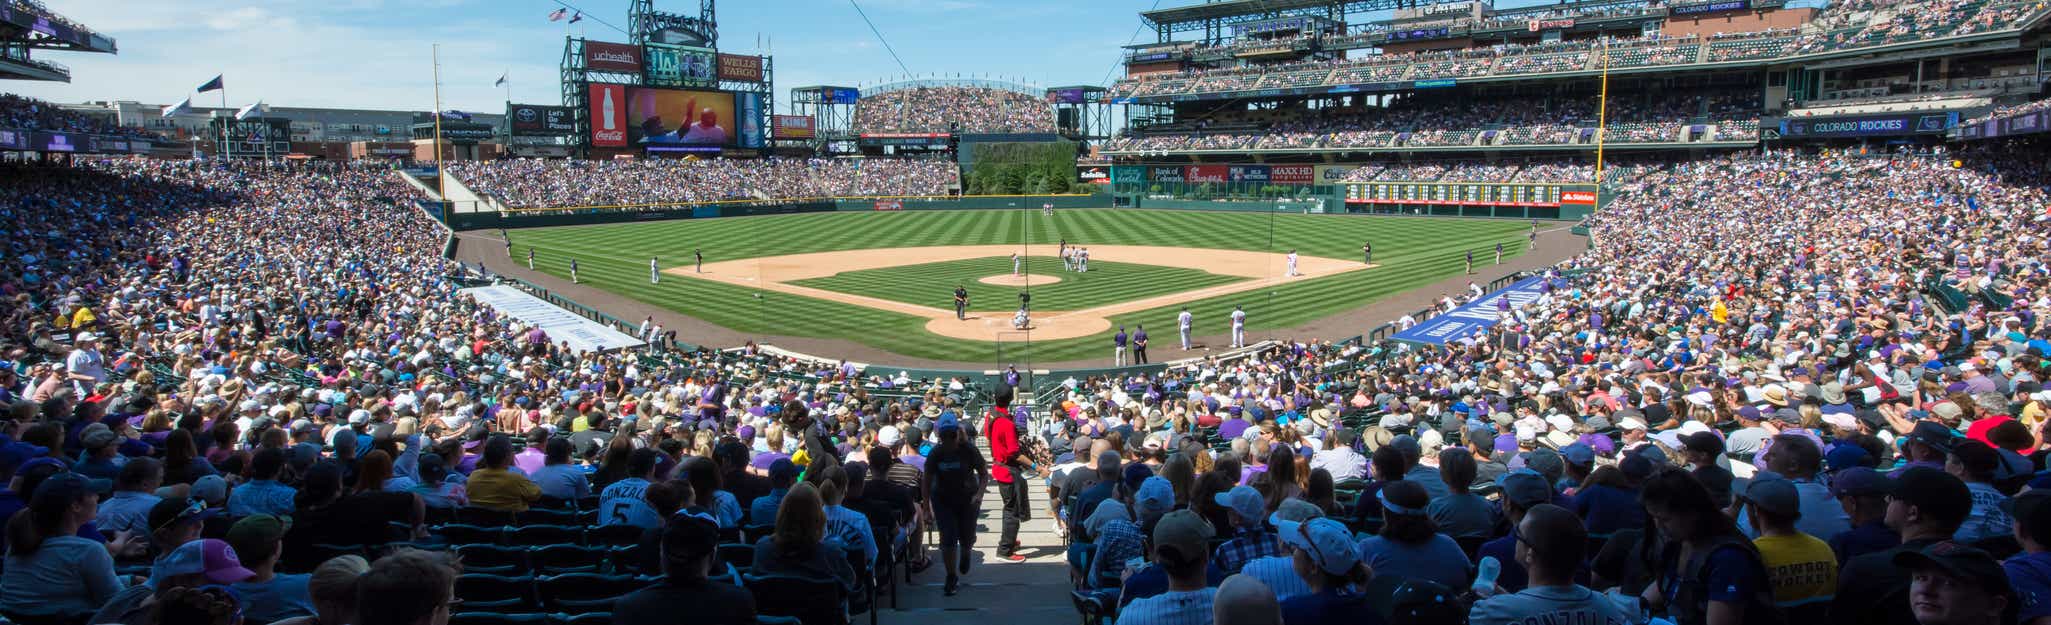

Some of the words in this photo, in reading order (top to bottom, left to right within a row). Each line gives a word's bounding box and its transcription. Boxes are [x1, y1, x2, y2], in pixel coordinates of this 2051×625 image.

[594, 50, 634, 64] uchealth
[722, 57, 757, 69] WELLS
[723, 67, 757, 78] FARGO
[1814, 121, 1857, 133] COLORADO
[1860, 119, 1902, 131] ROCKIES
[1155, 167, 1171, 175] Bank
[1172, 167, 1179, 175] of
[1271, 167, 1297, 175] MAXX
[1298, 167, 1313, 175] HD
[1155, 174, 1185, 183] Colorado
[613, 503, 631, 522] 5
